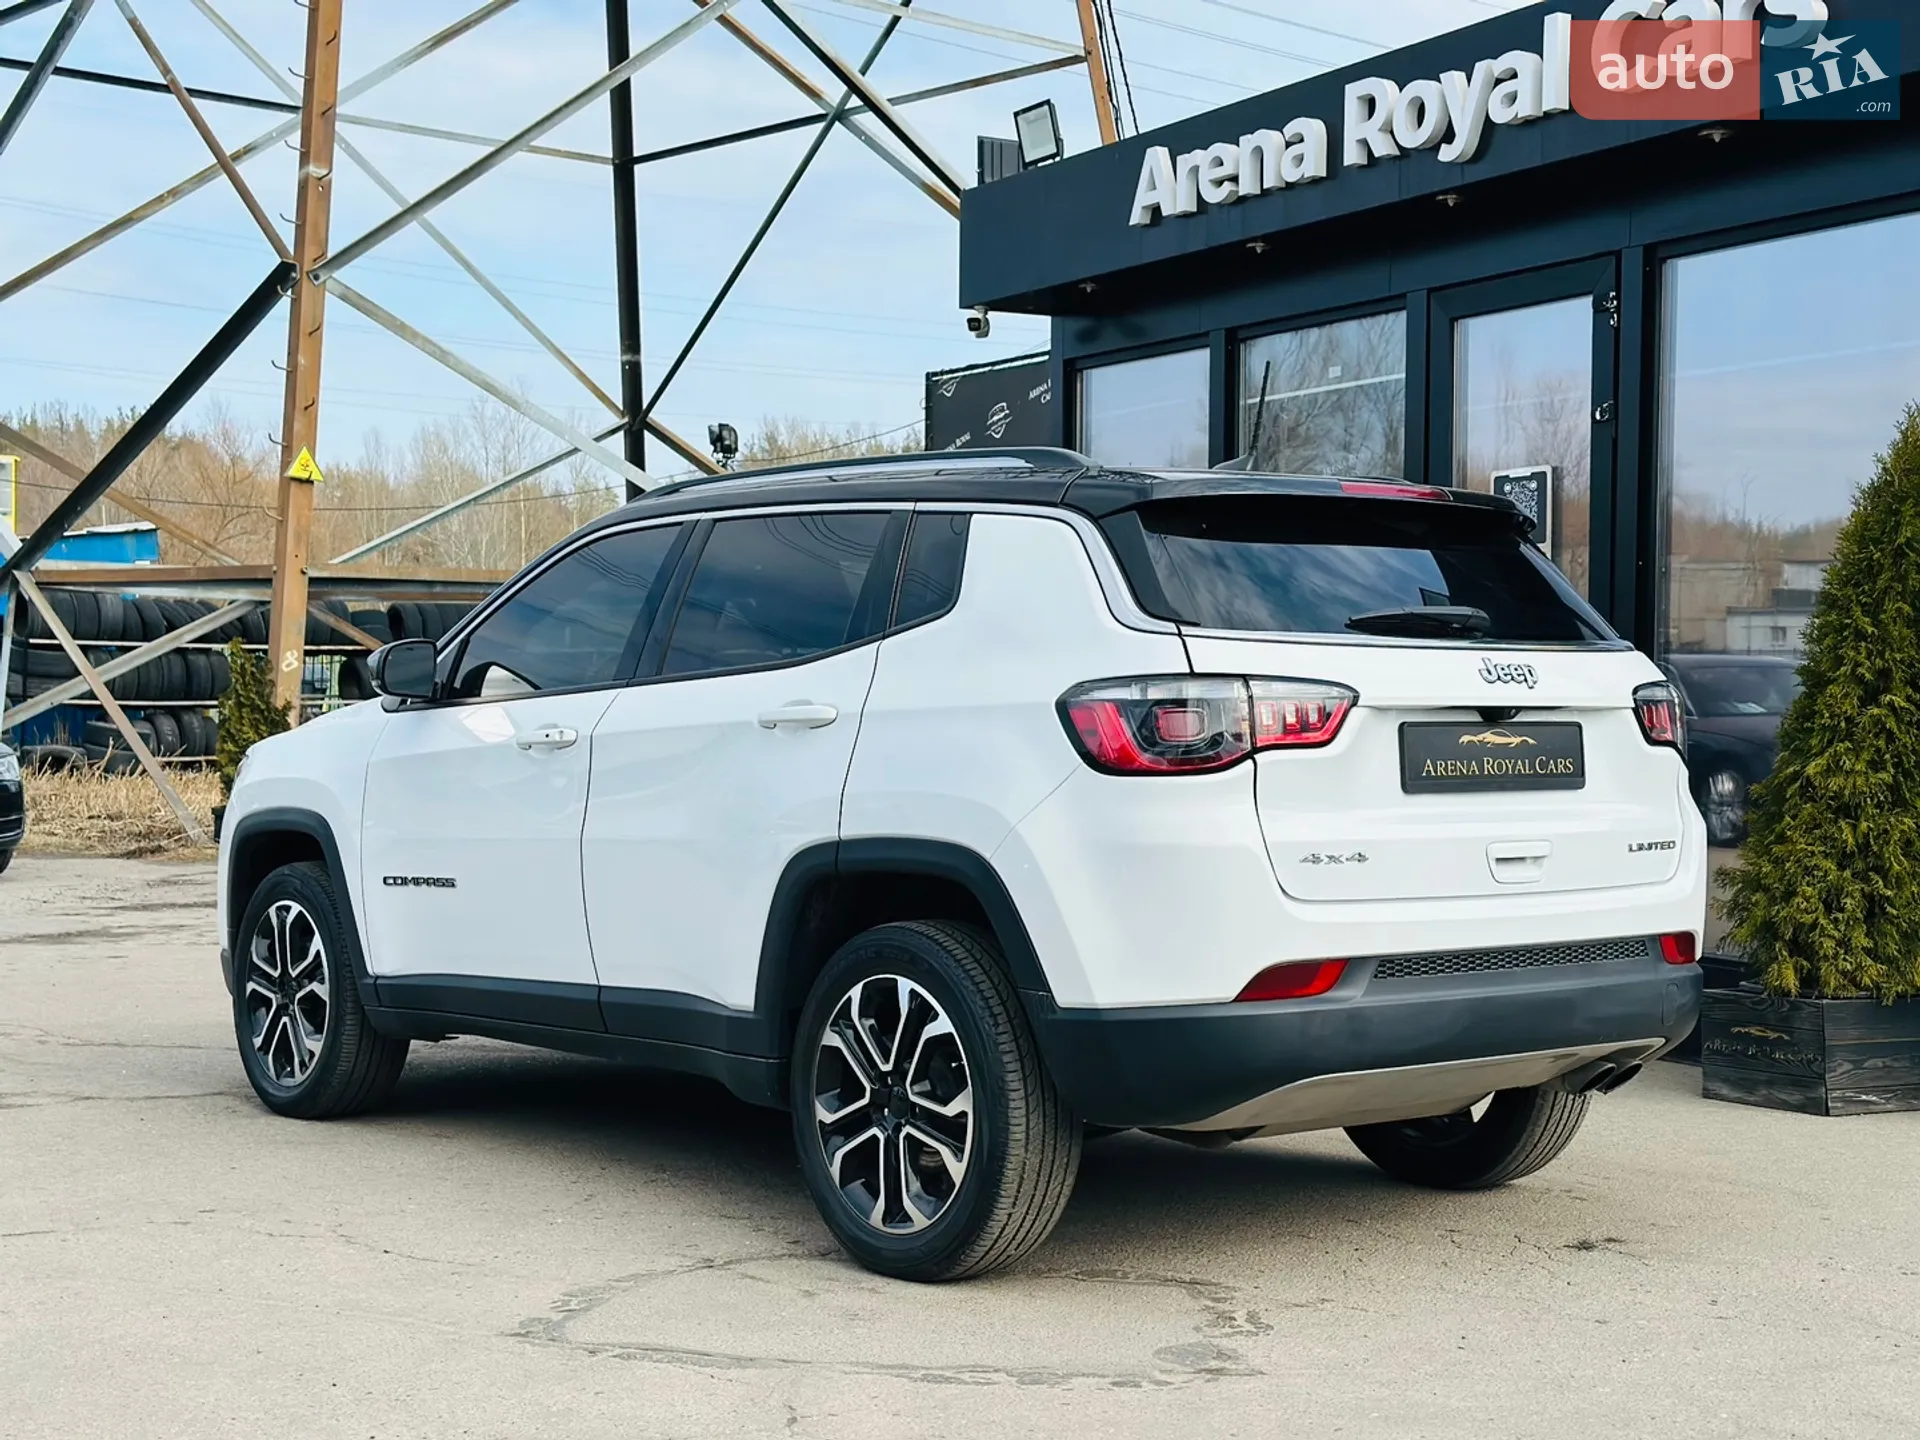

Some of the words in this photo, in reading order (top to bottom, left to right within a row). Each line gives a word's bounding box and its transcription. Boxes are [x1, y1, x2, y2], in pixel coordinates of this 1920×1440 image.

[1129, 116, 1328, 226] Arena
[1342, 11, 1571, 163] Royal
[1478, 657, 1539, 689] Jeep
[1422, 758, 1479, 777] ARENA
[1483, 757, 1534, 776] ROYAL
[1535, 755, 1574, 774] CARS
[1627, 840, 1677, 853] LIMITED
[382, 875, 458, 888] COMPASS
